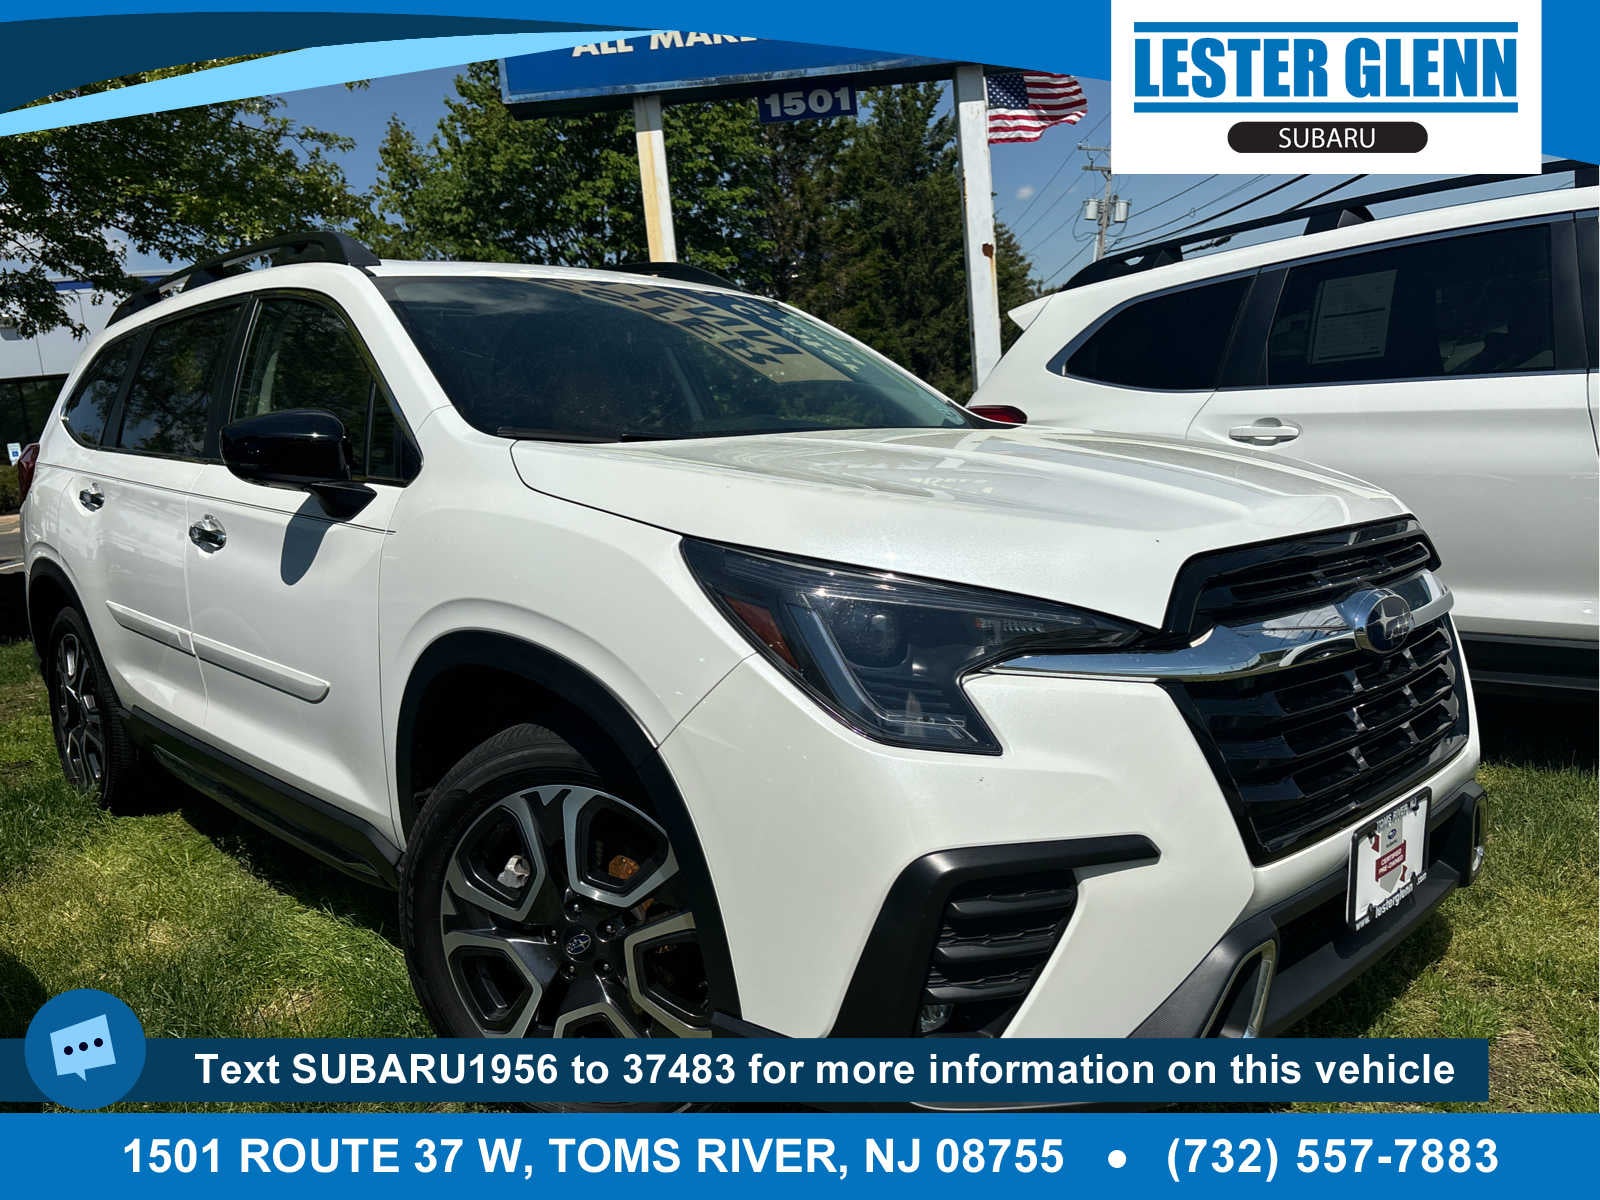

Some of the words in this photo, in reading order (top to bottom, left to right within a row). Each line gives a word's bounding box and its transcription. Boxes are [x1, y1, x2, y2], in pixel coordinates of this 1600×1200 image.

[571, 38, 634, 58] ALL
[650, 32, 757, 50] MAK
[764, 87, 851, 118] 1501
